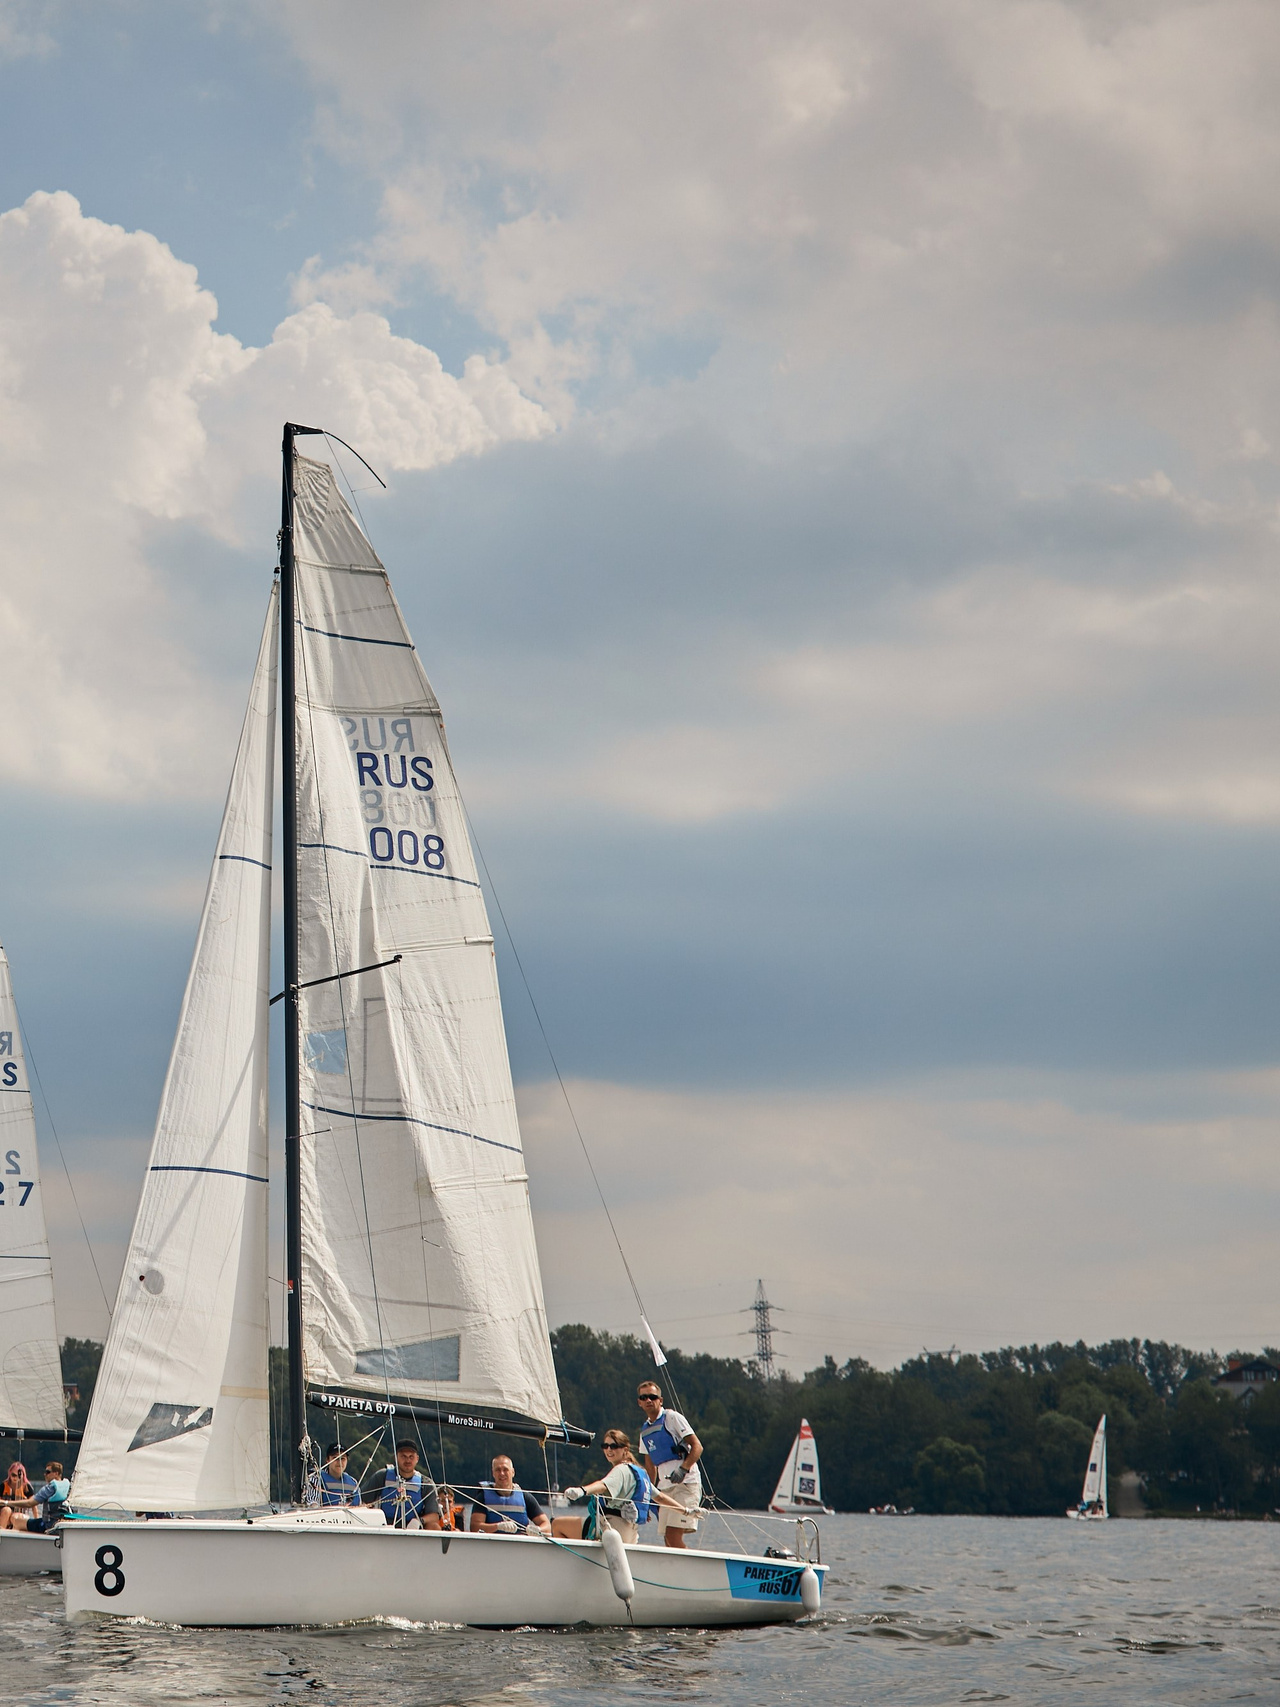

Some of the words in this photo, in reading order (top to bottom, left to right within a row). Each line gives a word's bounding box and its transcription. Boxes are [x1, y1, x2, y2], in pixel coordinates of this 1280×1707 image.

[356, 752, 434, 791] RUS
[370, 827, 445, 870] 008
[375, 1402, 396, 1415] 670
[448, 1414, 494, 1430] MoreSail.ru
[94, 1544, 126, 1597] 8
[781, 1570, 802, 1597] 67
